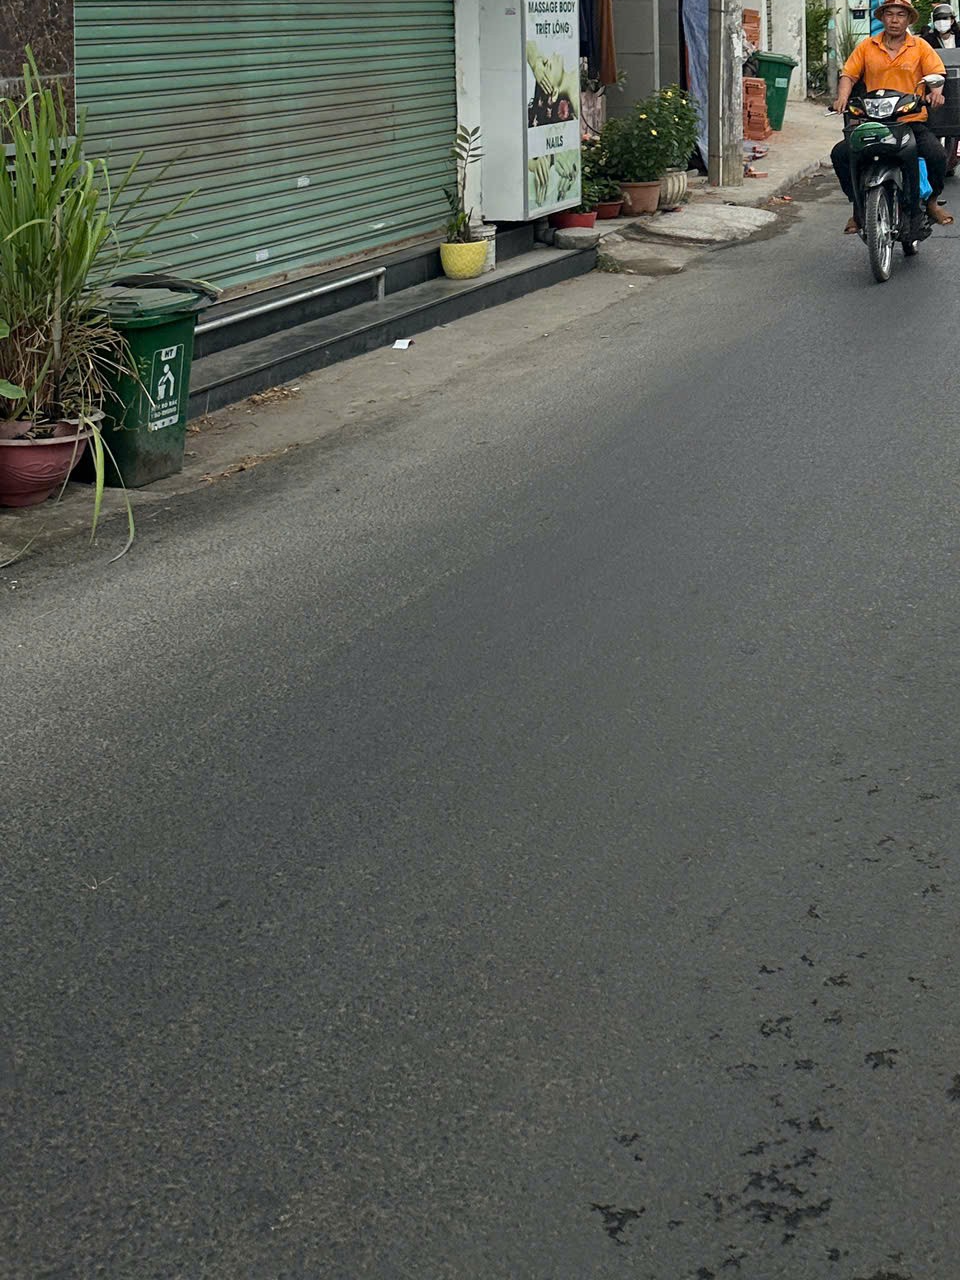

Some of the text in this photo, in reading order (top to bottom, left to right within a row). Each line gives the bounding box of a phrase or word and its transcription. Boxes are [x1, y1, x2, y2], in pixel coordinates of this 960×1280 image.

[528, 1, 558, 14] MASSAGE
[559, 1, 576, 14] BODY
[535, 19, 551, 39] TRIỆT
[545, 135, 564, 150] NAILS
